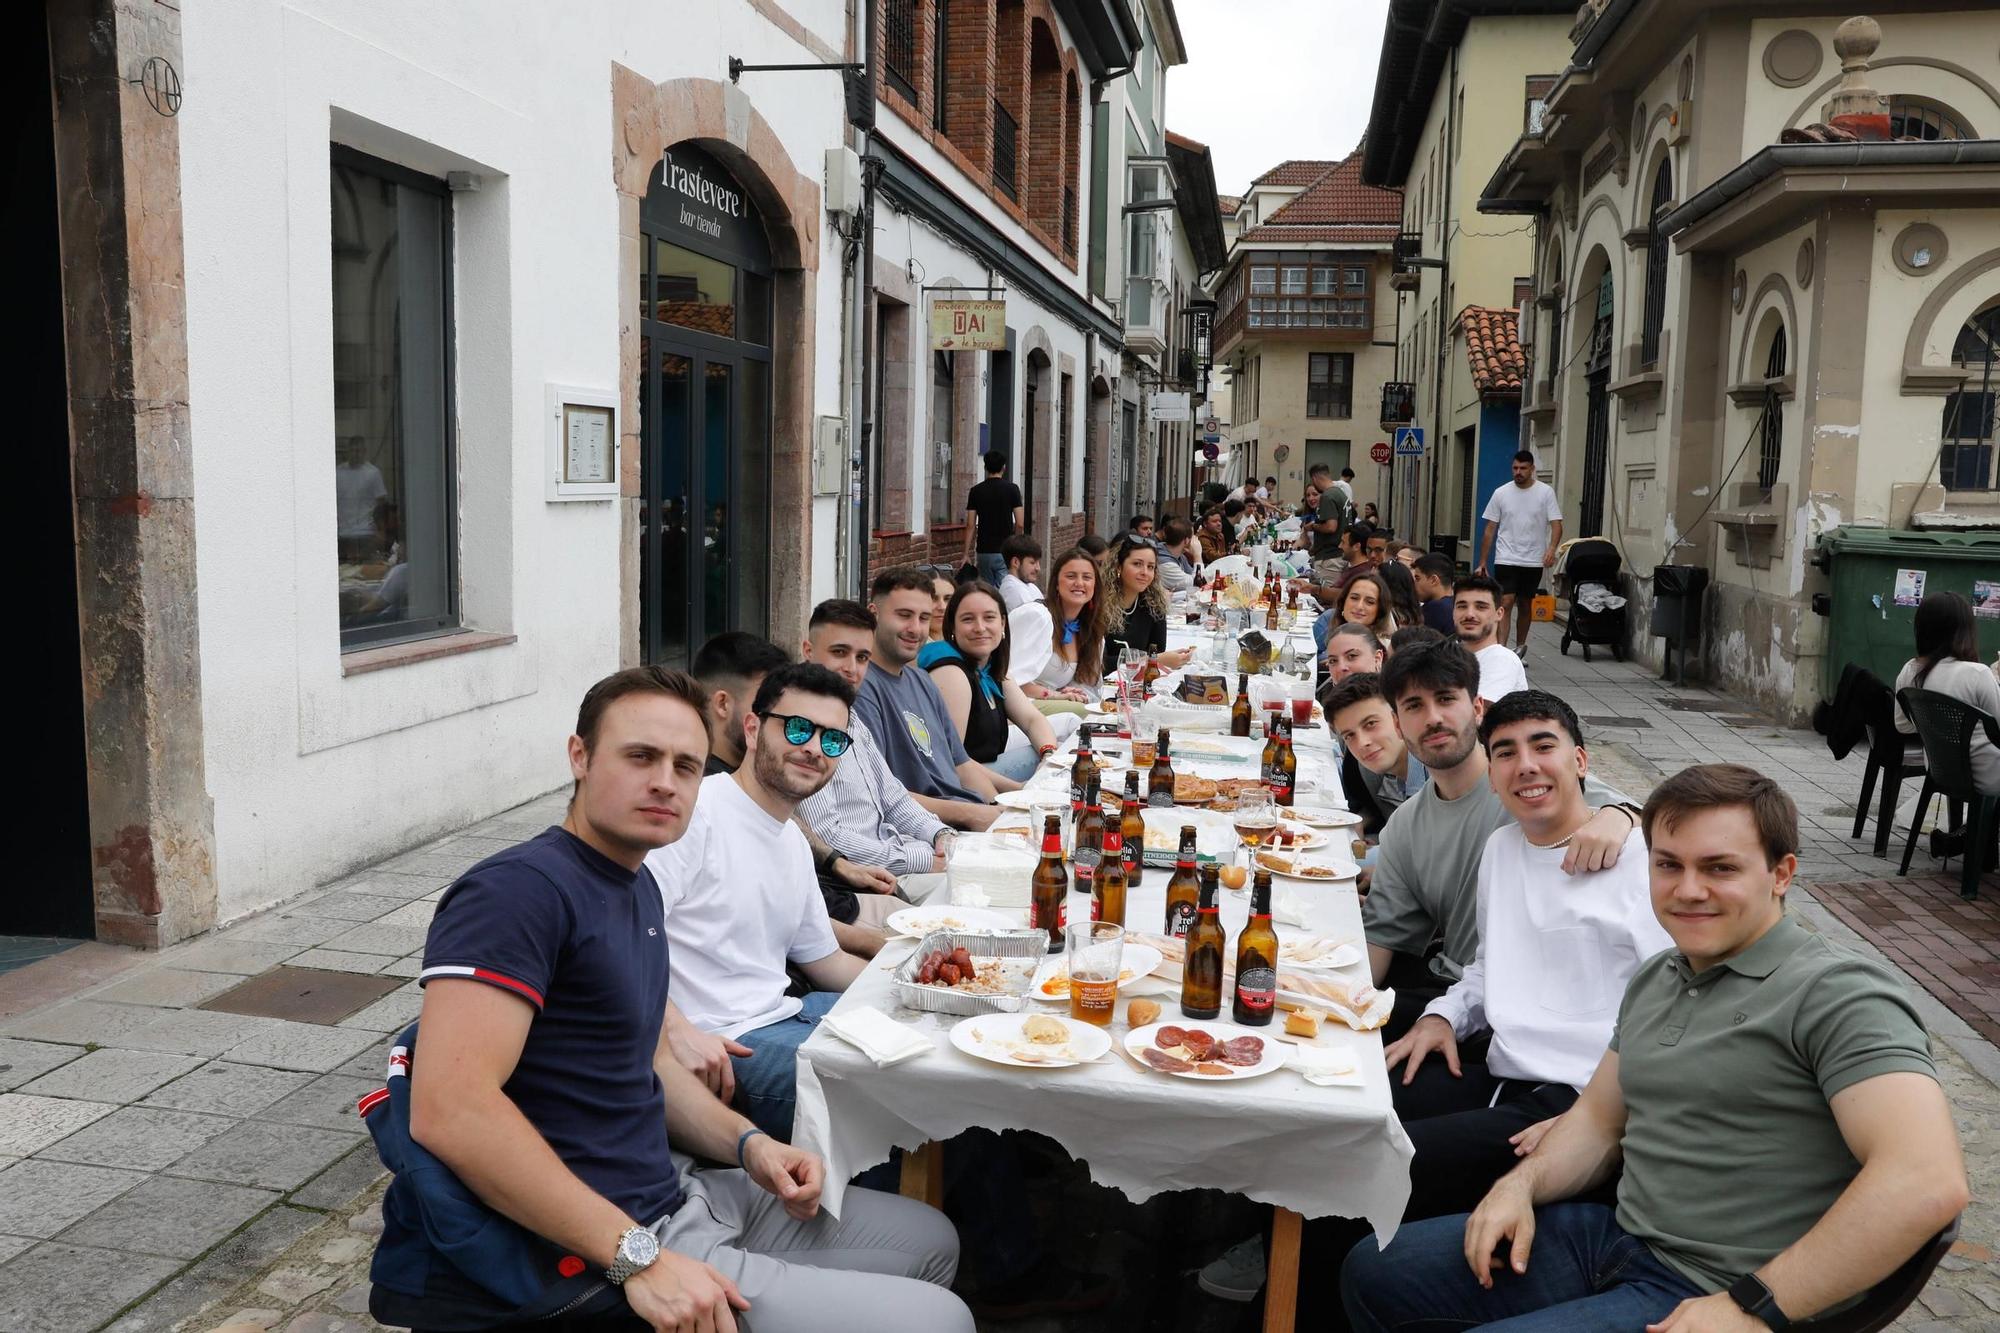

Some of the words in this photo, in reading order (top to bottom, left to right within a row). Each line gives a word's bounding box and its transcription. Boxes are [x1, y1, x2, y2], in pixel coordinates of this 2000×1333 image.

[662, 151, 740, 217] Trastevere
[680, 203, 697, 228] bar
[697, 214, 721, 239] tienda
[1371, 449, 1390, 457] STOP
